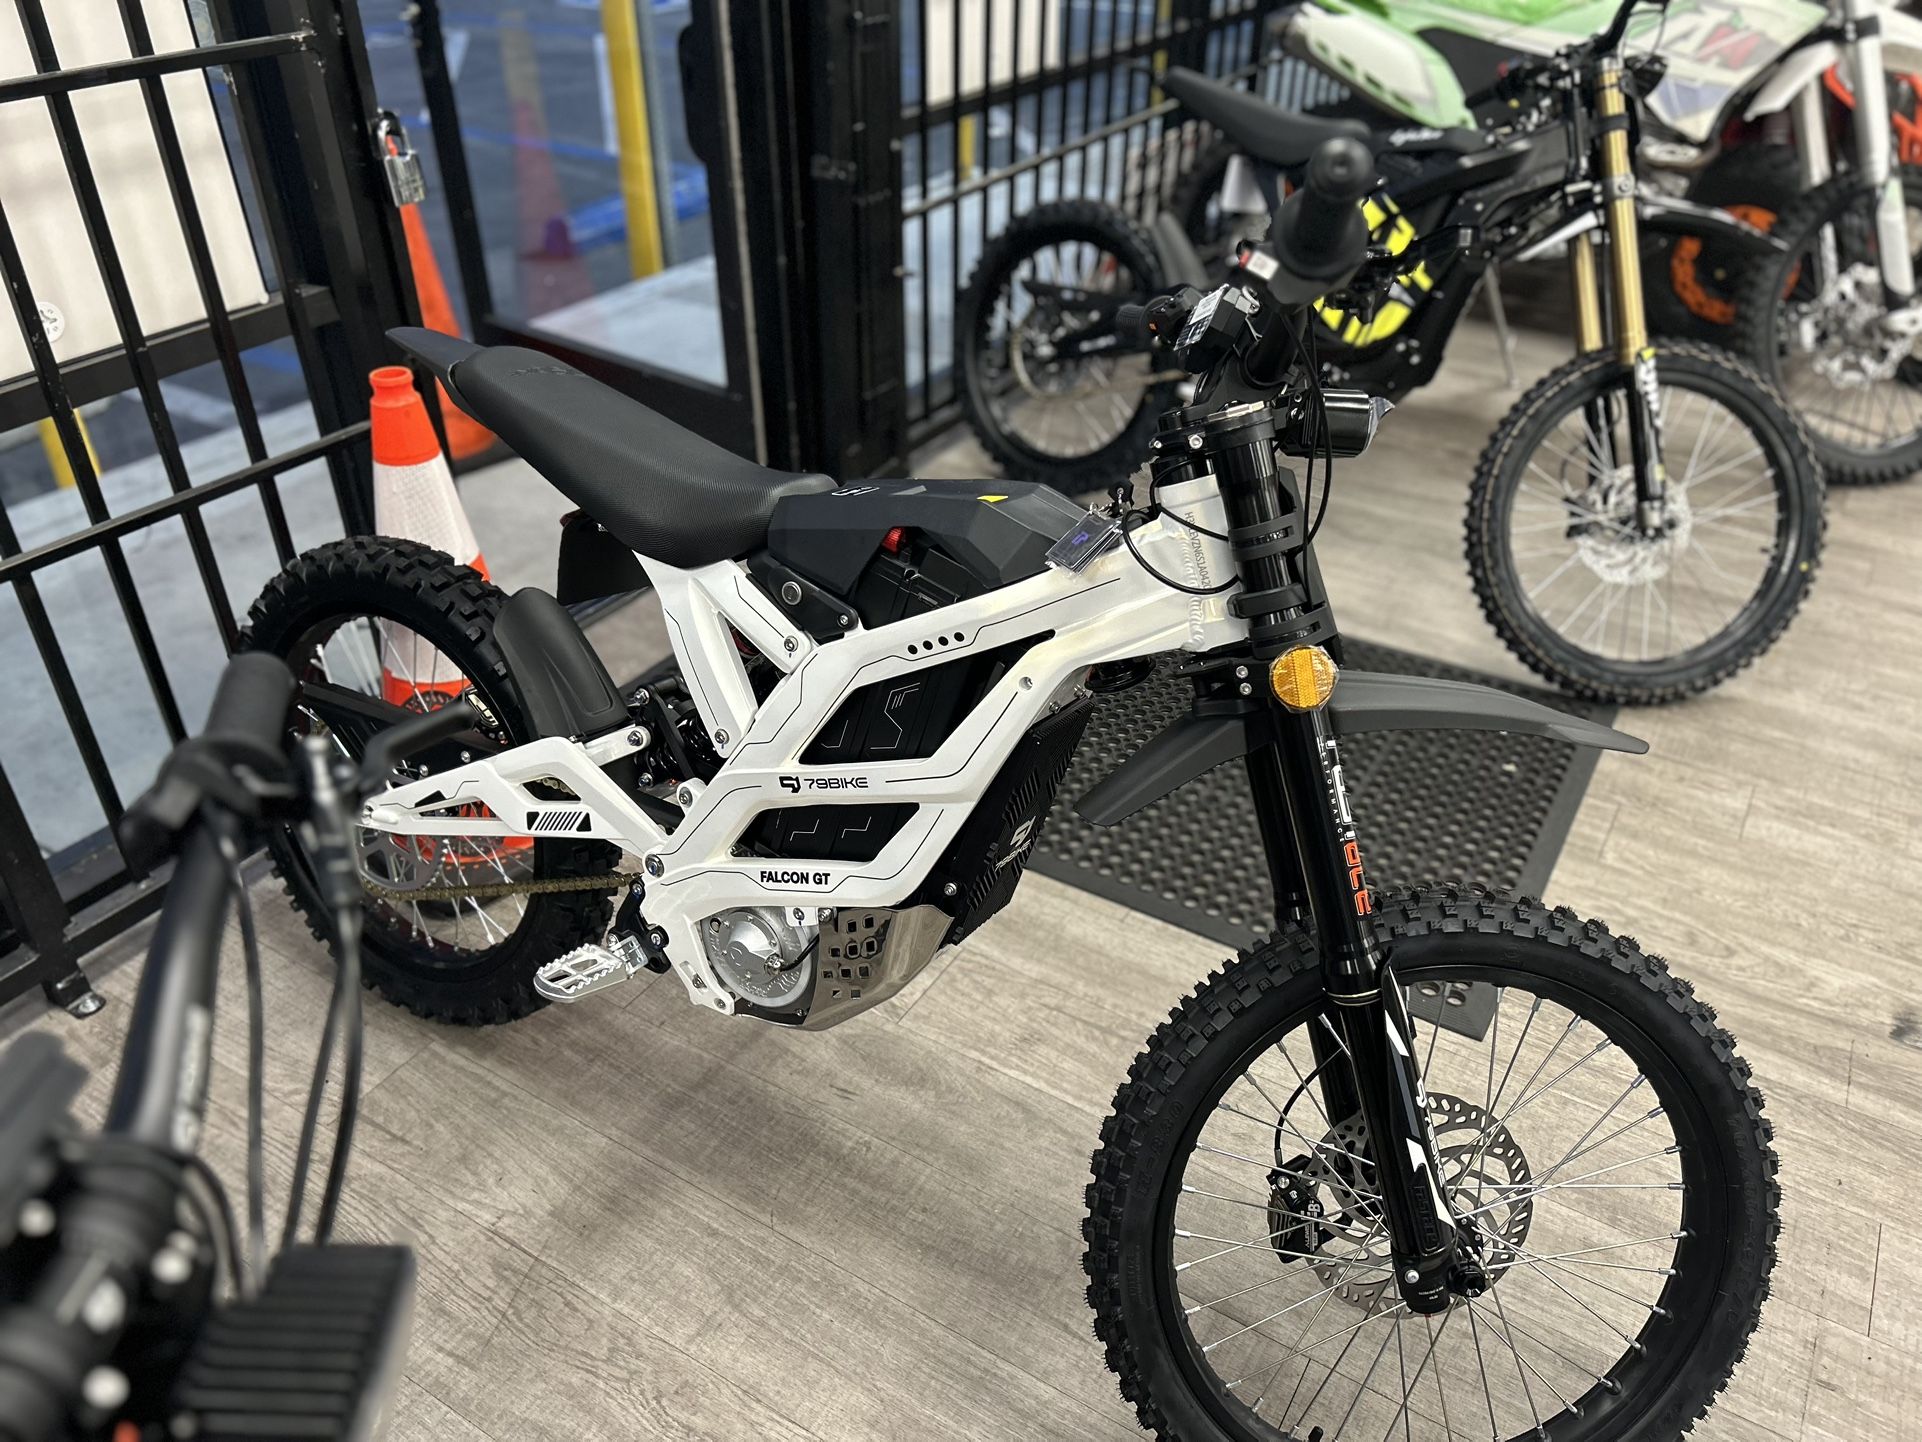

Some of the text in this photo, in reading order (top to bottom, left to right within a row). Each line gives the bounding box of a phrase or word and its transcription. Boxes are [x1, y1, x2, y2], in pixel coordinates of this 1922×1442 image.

[803, 777, 869, 789] 79BIKE
[760, 870, 831, 885] FALCON GT
